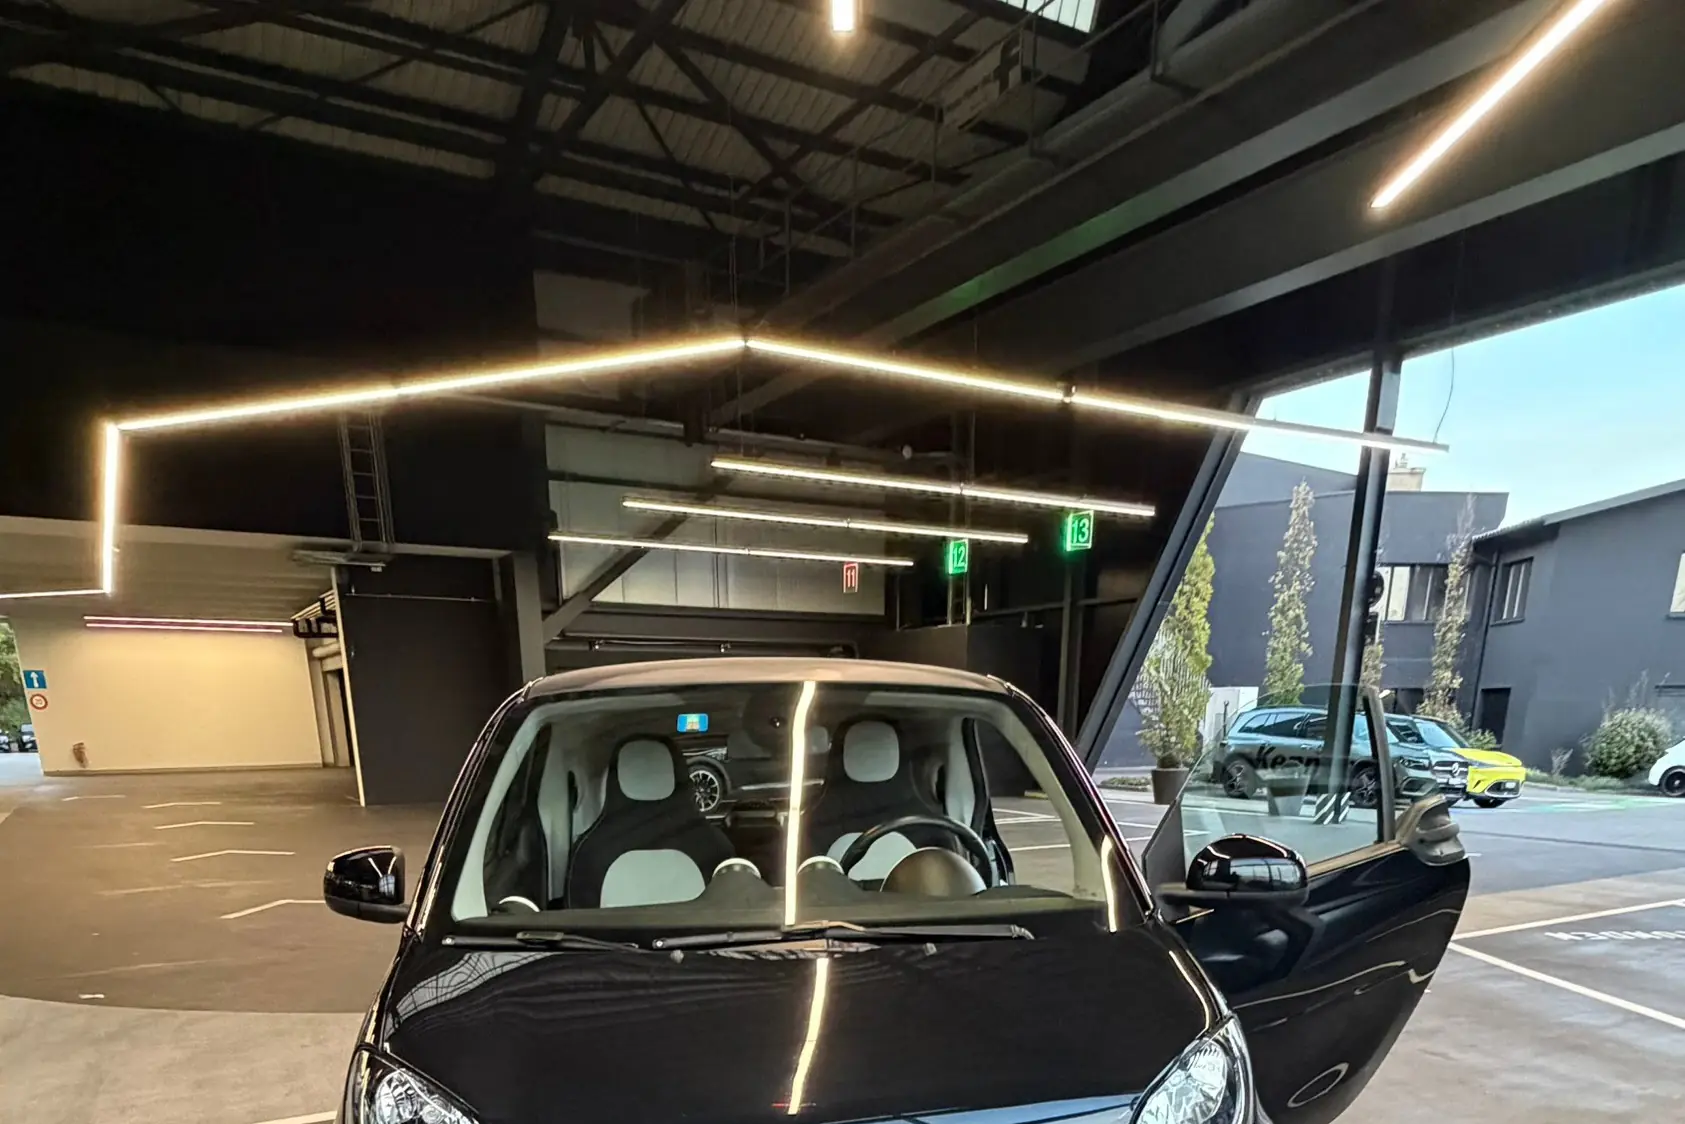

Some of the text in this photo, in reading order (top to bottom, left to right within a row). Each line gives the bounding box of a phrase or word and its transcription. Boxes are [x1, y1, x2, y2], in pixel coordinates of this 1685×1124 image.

[1072, 518, 1089, 545] 13
[953, 545, 966, 567] 12
[846, 569, 855, 587] 11
